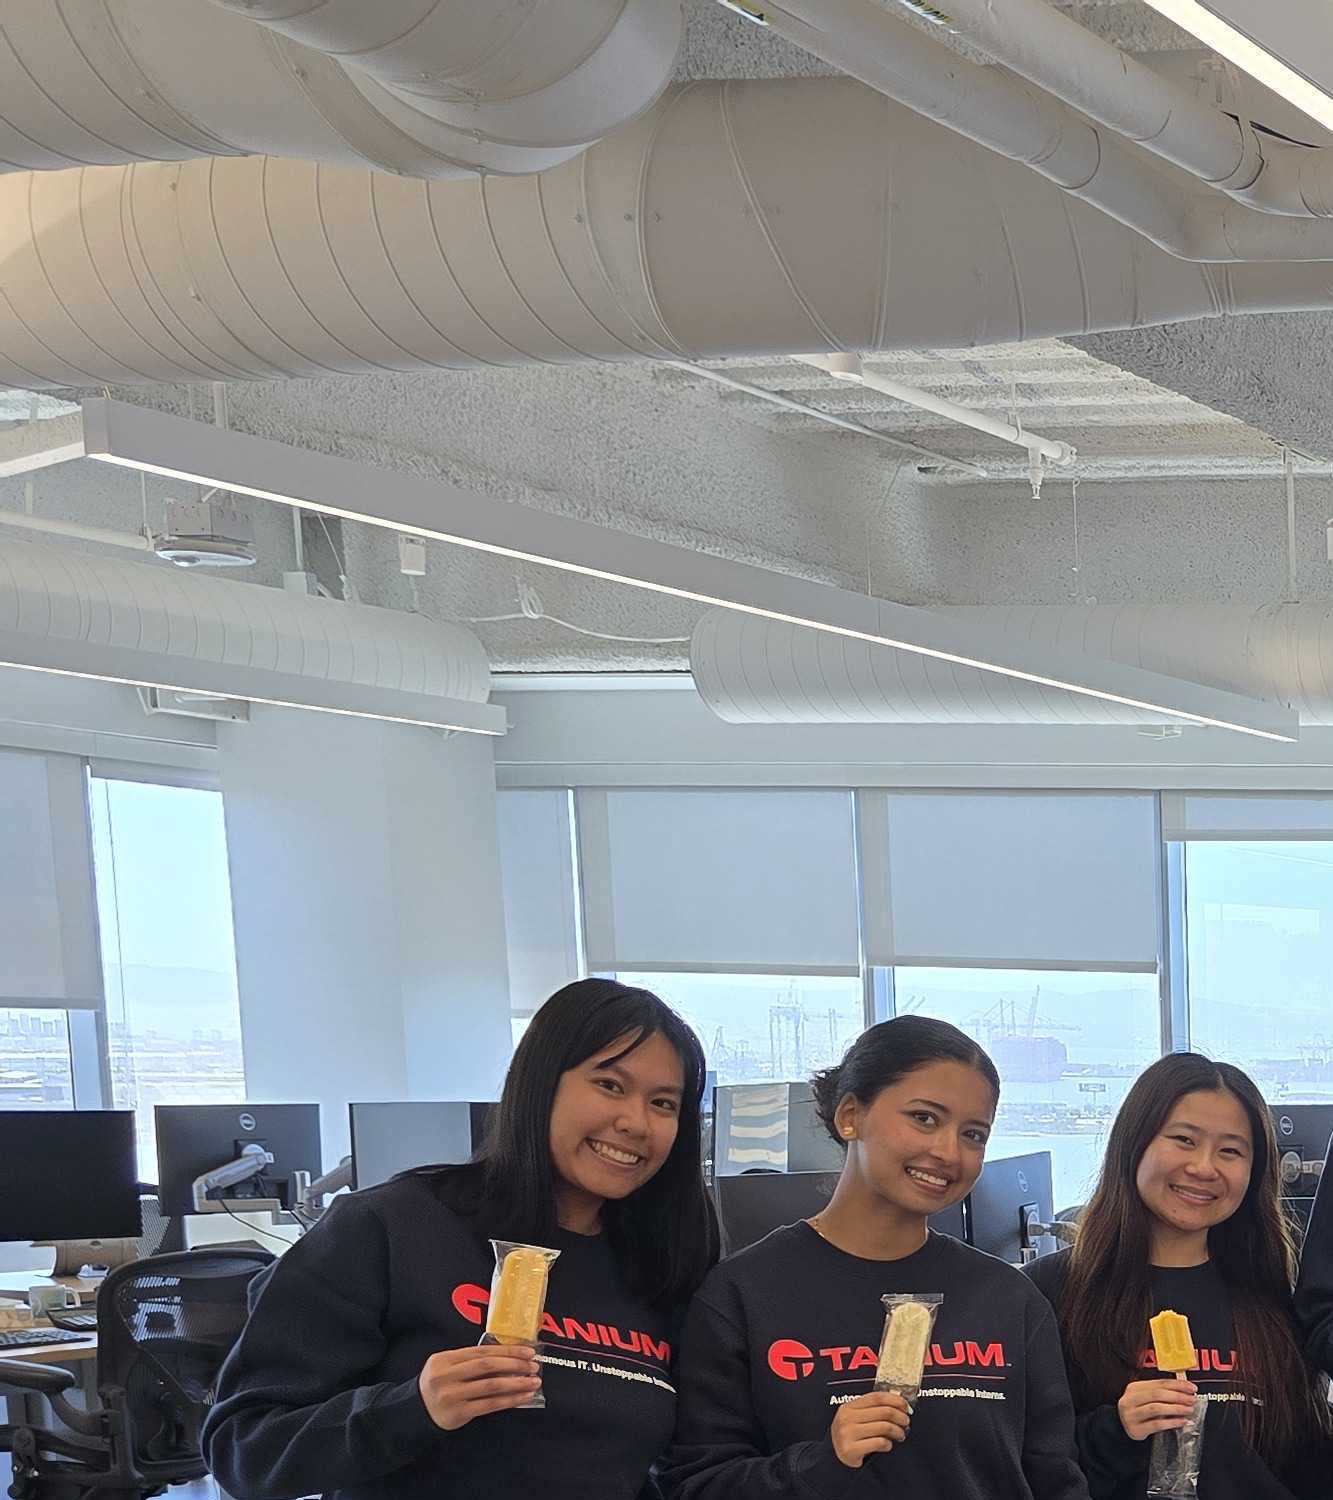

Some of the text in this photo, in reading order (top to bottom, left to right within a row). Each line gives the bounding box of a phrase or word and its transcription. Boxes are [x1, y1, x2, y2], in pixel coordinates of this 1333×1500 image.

[537, 1310, 671, 1364] ANIUM
[534, 1353, 577, 1368] nomous
[591, 1362, 654, 1384] Unstoppable
[820, 1341, 1004, 1371] TAUM
[917, 1388, 975, 1399] nstoppable
